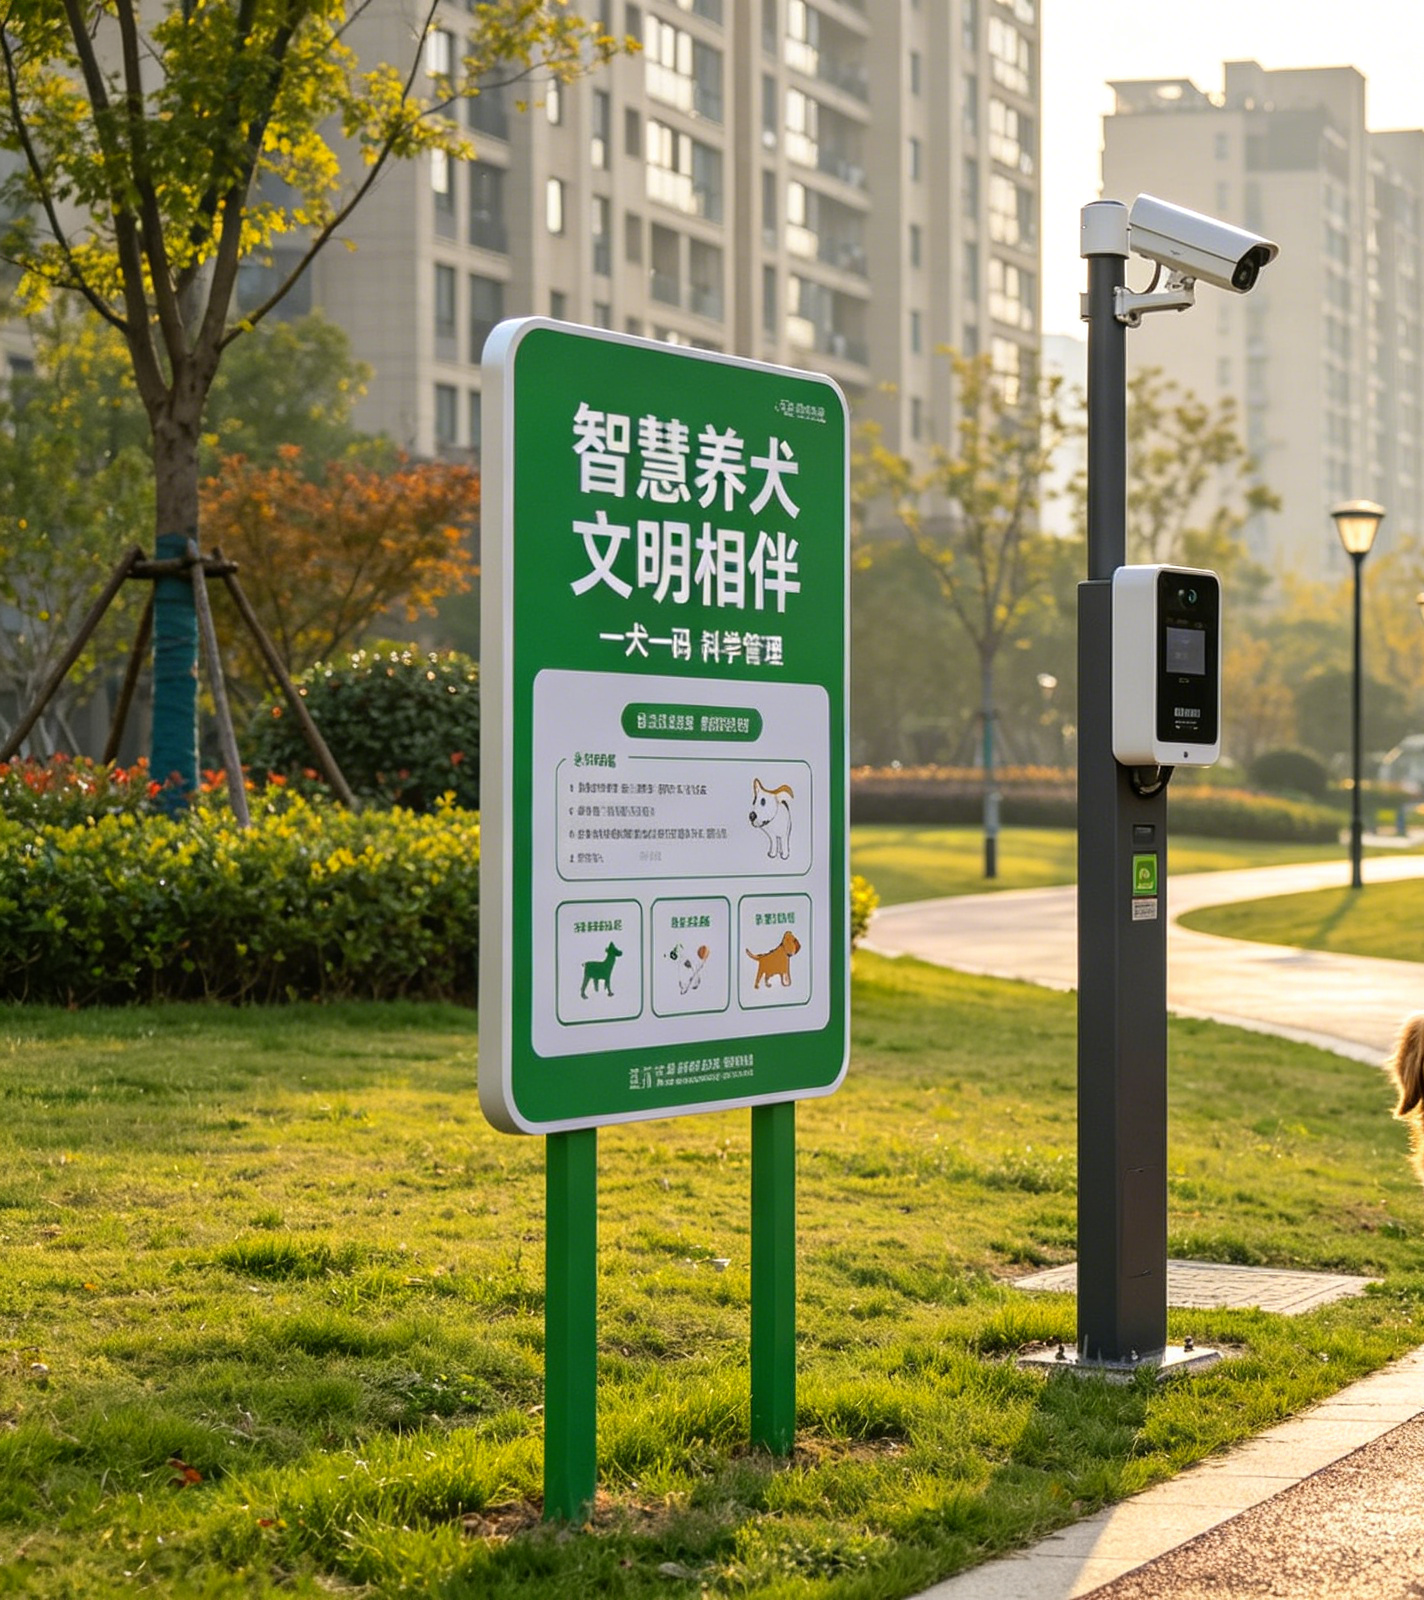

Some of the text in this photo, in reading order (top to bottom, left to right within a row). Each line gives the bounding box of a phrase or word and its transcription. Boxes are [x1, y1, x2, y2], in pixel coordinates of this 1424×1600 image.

[573, 402, 800, 519] 智慧养犬
[570, 510, 801, 613] 文明相伴
[599, 622, 784, 666] 一犬一码 科学管理
